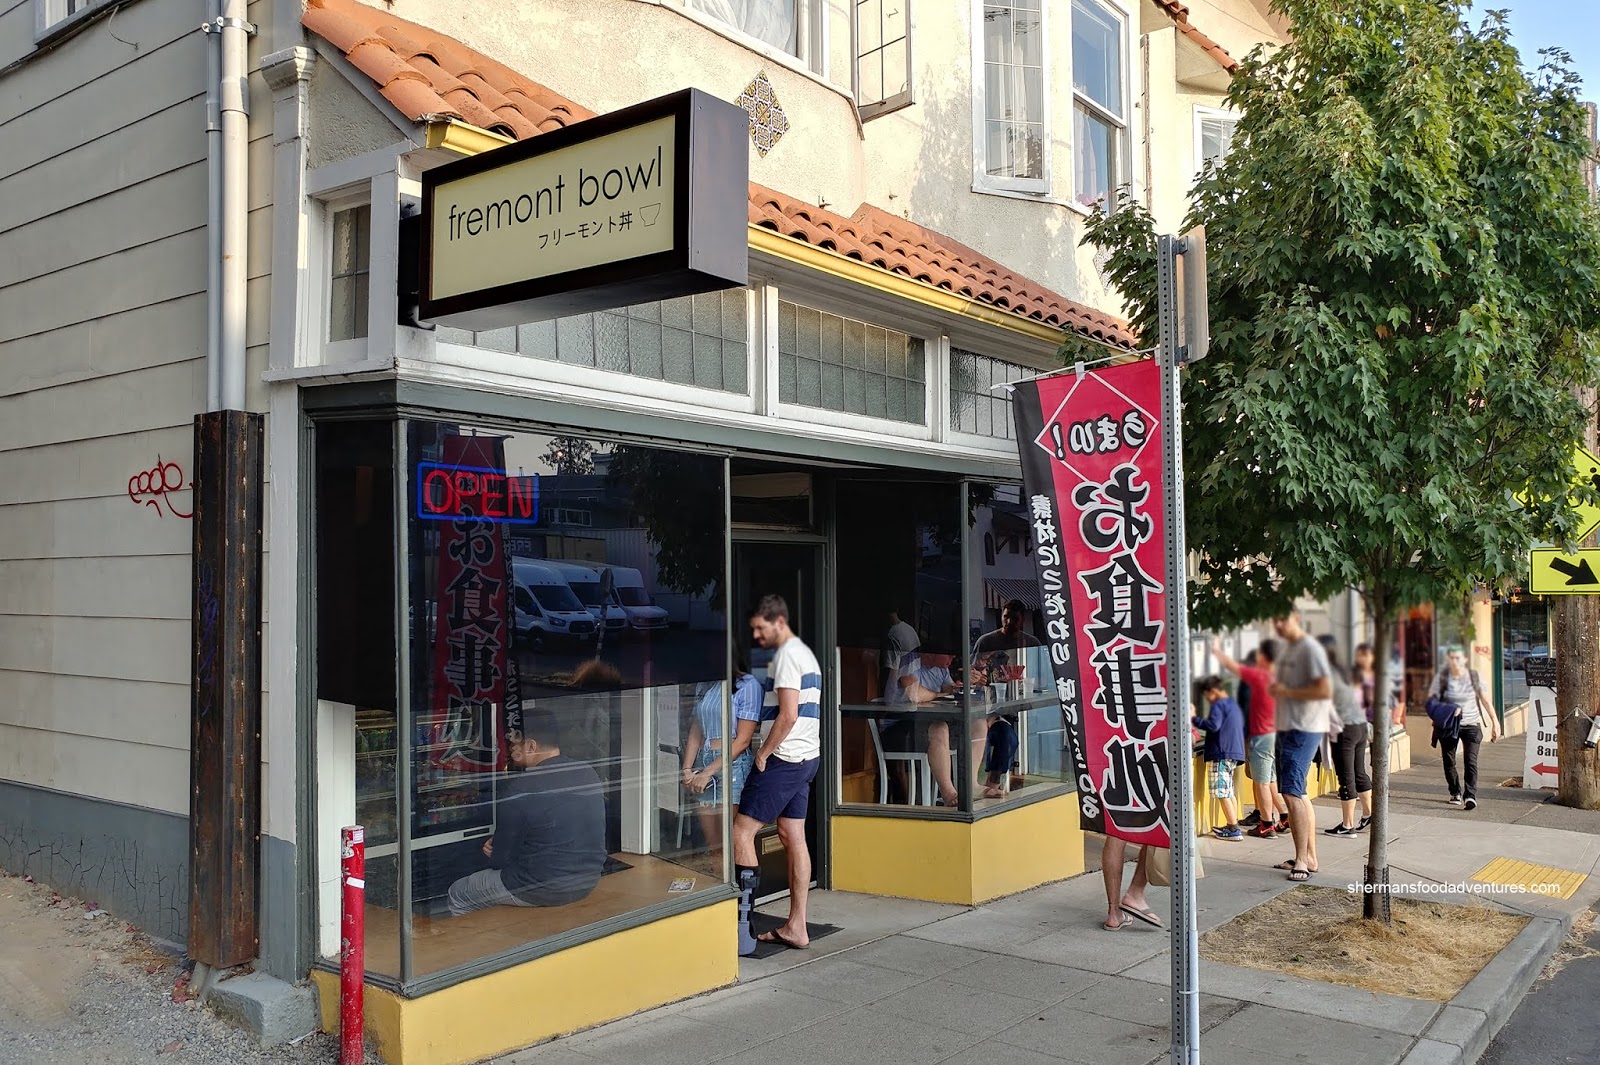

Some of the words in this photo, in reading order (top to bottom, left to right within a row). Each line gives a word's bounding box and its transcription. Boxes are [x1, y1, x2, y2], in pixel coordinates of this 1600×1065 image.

[448, 174, 566, 242] fremont
[579, 145, 662, 207] bowl
[538, 211, 633, 250] フリーモント丼
[424, 470, 532, 518] OPEN
[1536, 731, 1558, 743] Ope
